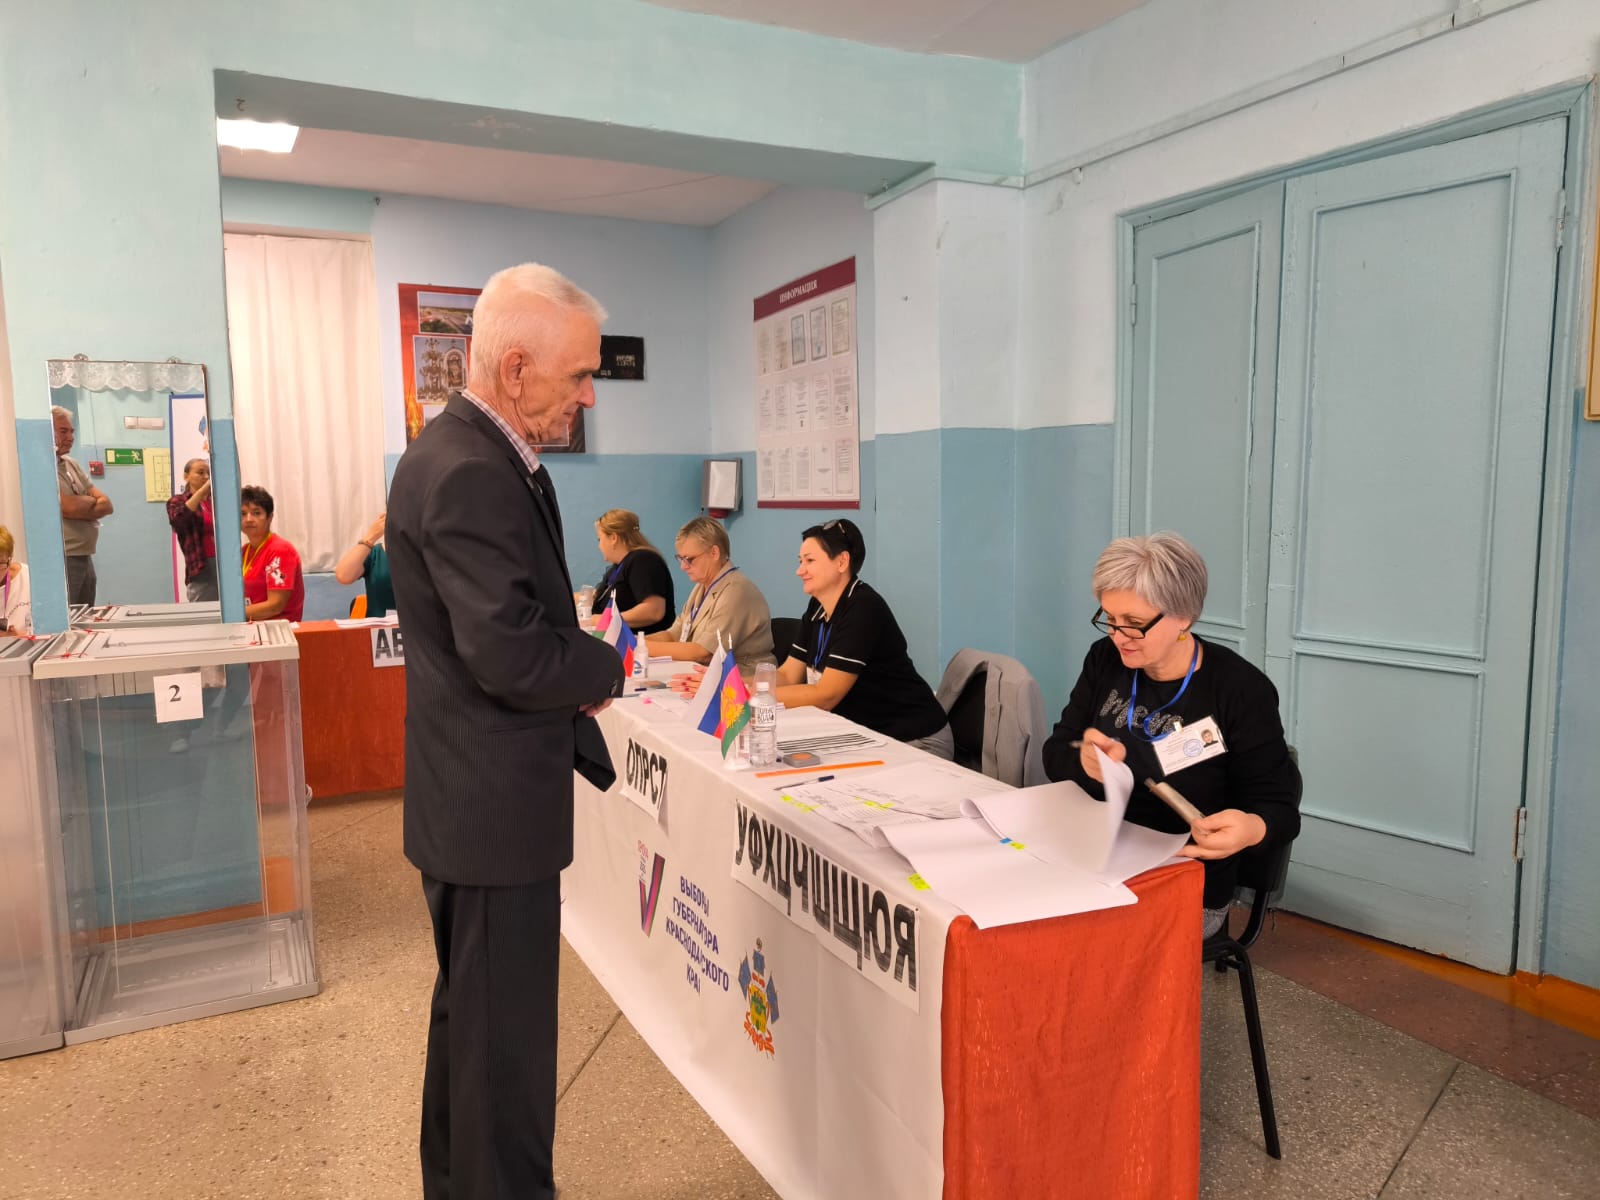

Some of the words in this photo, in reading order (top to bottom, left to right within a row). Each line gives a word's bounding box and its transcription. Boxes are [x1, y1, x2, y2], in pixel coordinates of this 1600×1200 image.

[778, 279, 818, 304] ИНФОРМАЦИЯ
[168, 684, 182, 702] 2
[626, 736, 667, 811] ОПРСТ
[680, 875, 710, 917] ВЫБОРЫ
[735, 799, 917, 992] УФХЦЧШЩЮЯ
[673, 896, 719, 954] ГУБЕРНАТОРА
[666, 916, 729, 992] КРАСНОДАСКОГО
[687, 963, 701, 996] КРА
